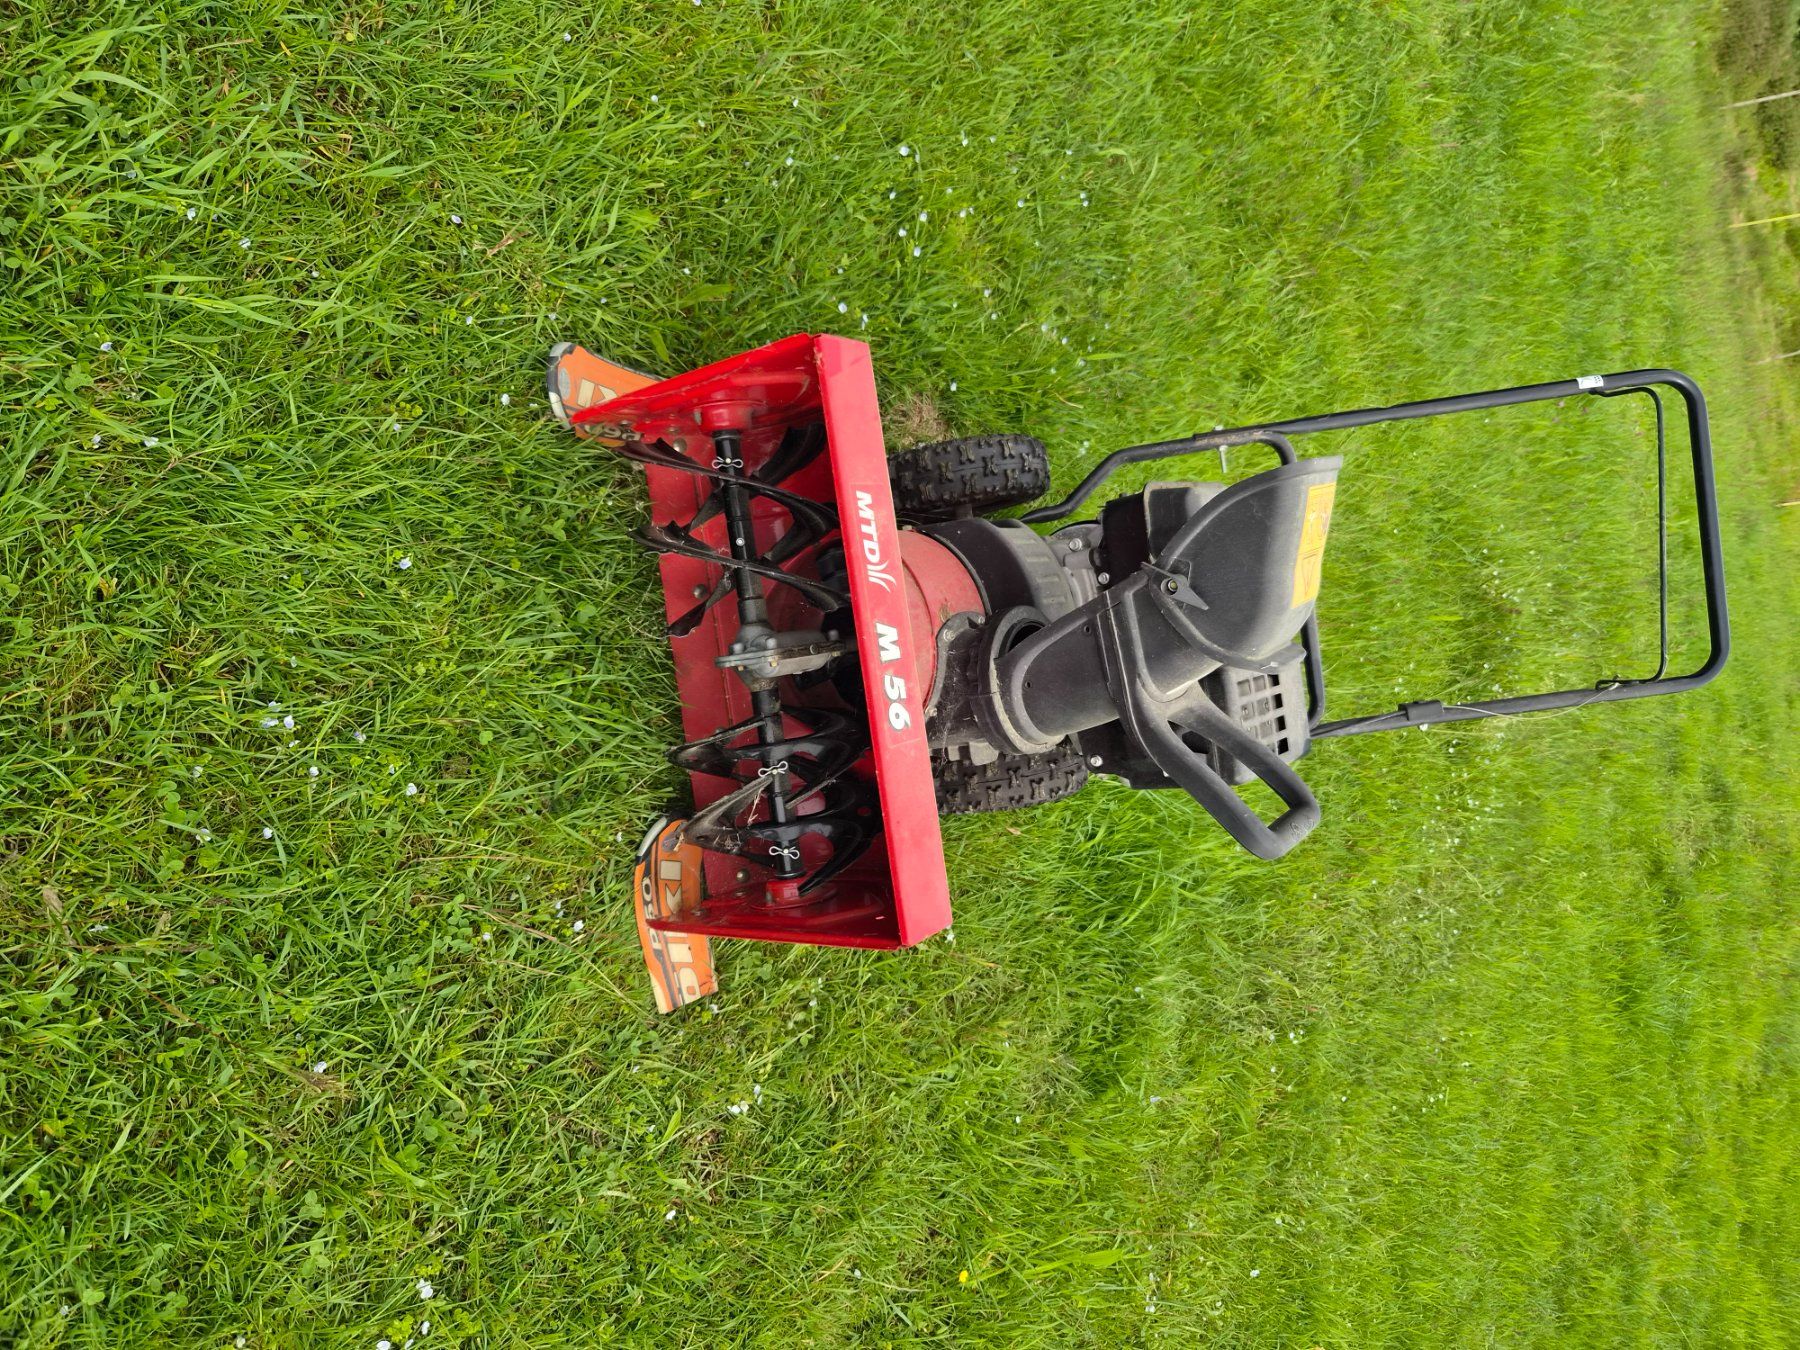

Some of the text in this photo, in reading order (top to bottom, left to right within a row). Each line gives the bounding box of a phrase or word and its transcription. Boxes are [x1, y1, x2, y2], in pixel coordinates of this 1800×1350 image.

[855, 490, 880, 562] MTD
[874, 621, 911, 731] M 56
